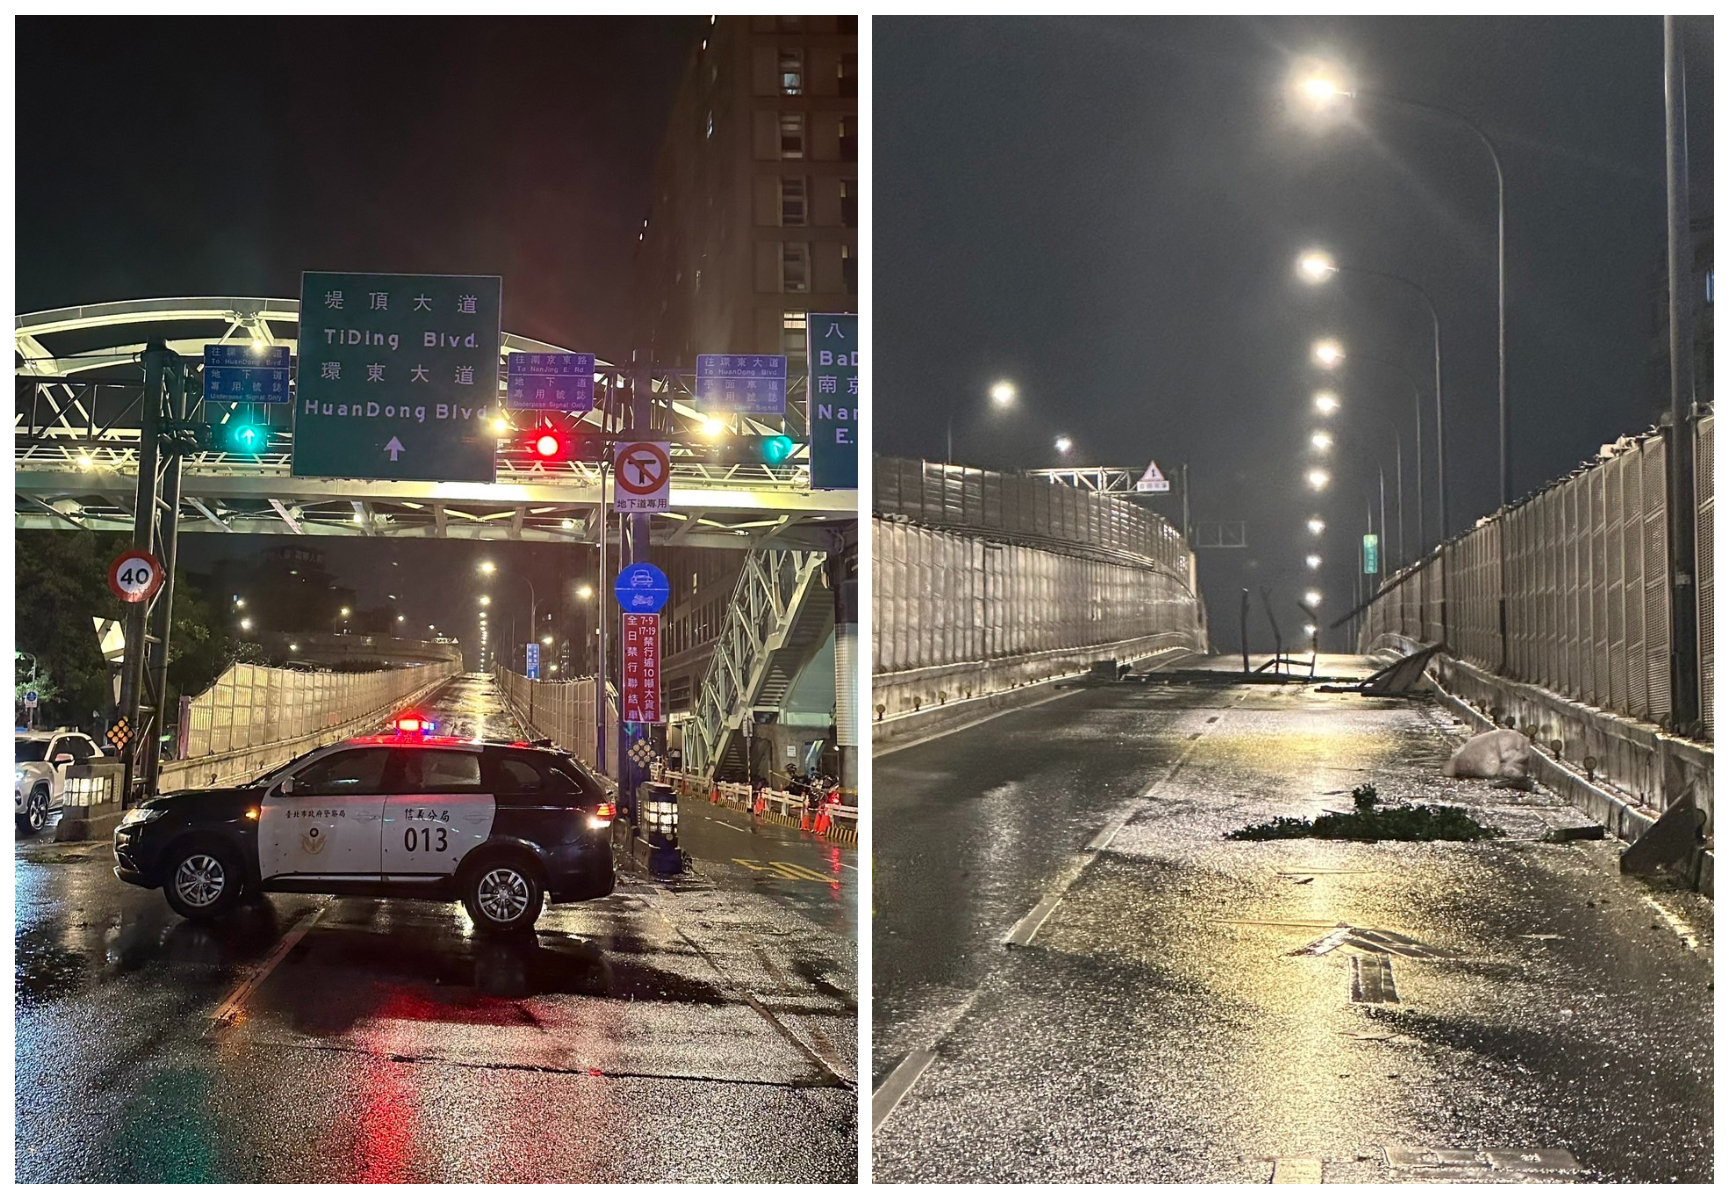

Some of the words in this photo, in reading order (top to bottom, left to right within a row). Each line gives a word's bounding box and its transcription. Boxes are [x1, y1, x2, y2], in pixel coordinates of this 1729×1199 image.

[324, 290, 478, 314] 堤頂大道
[324, 328, 399, 350] TiDing
[423, 331, 479, 349] Blvd.
[515, 355, 587, 365] 往南京東路
[704, 357, 779, 368] 往環東大道
[211, 369, 283, 380] 地下道
[320, 362, 475, 386] 環東大道
[530, 366, 559, 374] NanJing
[515, 377, 587, 388] 地下道
[704, 379, 778, 390] 平面車道
[304, 400, 426, 423] HuanDong
[836, 428, 854, 444] E.
[617, 498, 667, 509] 地下道專用
[120, 568, 149, 585] 40
[285, 809, 346, 819] 臺北市政府警察局
[404, 808, 450, 823] 信義分局
[404, 827, 448, 852] 013
